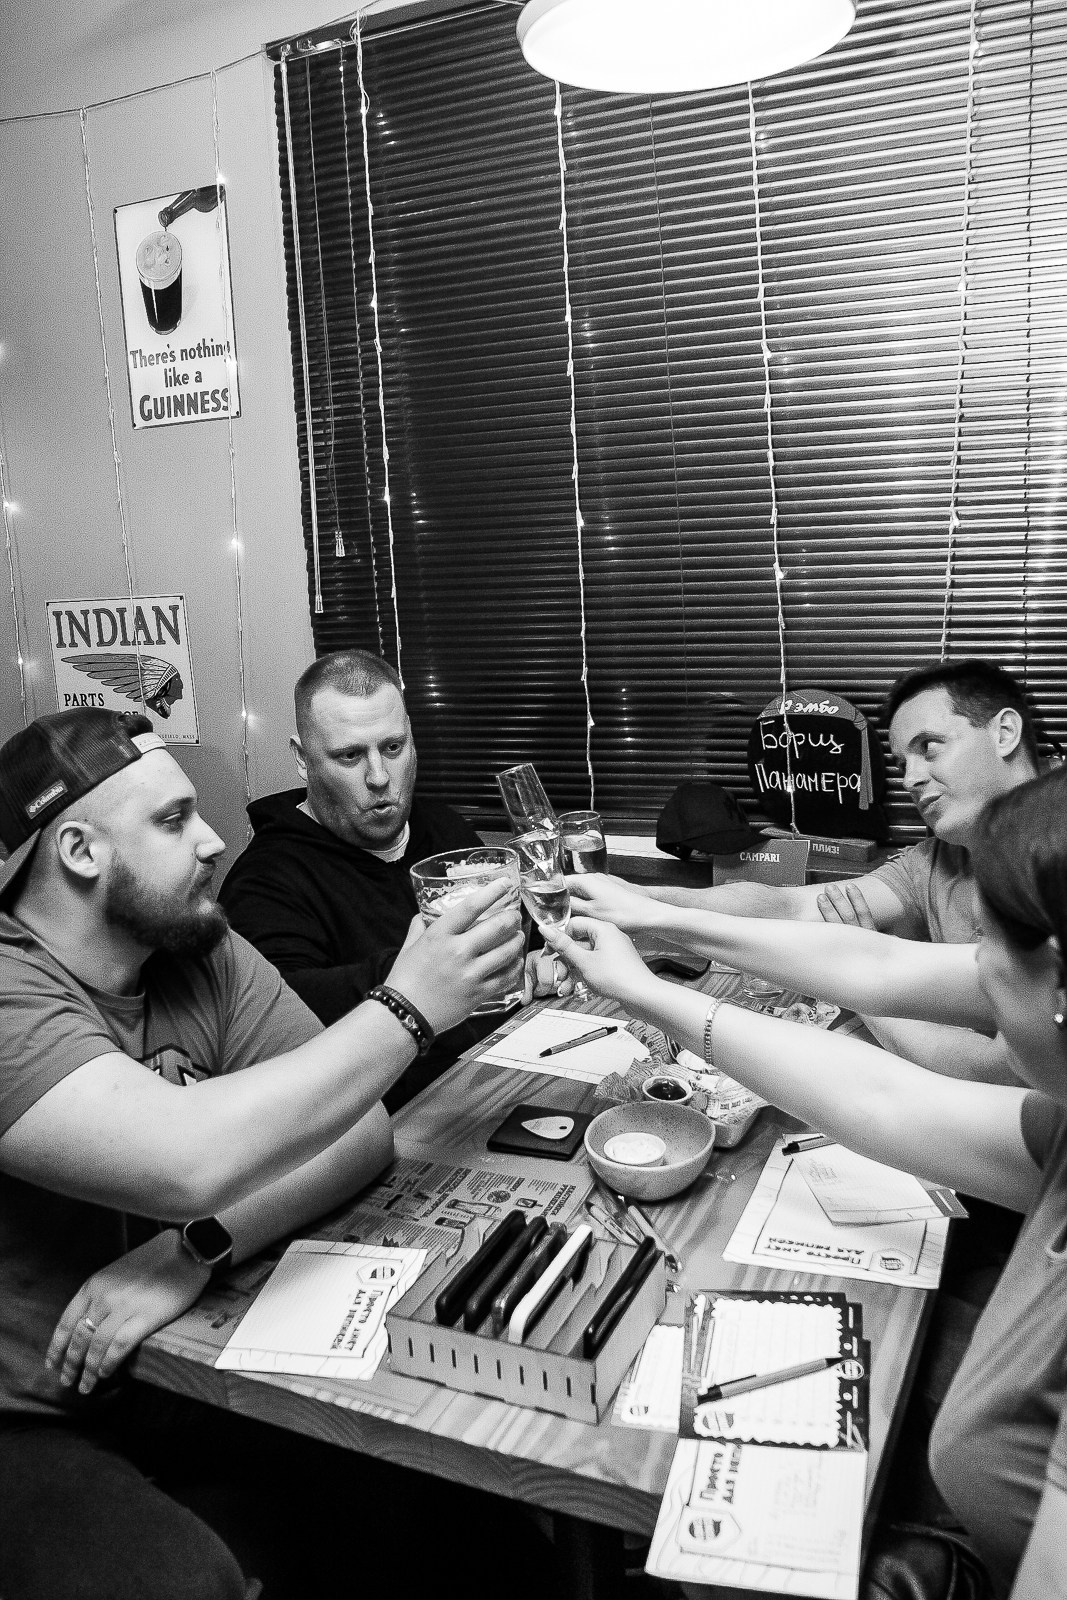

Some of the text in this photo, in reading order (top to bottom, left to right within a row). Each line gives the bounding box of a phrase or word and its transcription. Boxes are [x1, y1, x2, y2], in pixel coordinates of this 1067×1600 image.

[129, 343, 177, 369] There's
[163, 366, 203, 388] like a
[139, 387, 229, 422] GUINNESS
[52, 604, 181, 648] INDIAN
[63, 692, 105, 707] PARTS
[759, 719, 844, 759] Борщ
[739, 851, 780, 863] CAMPARI
[812, 843, 840, 855] ПЛИЗ!
